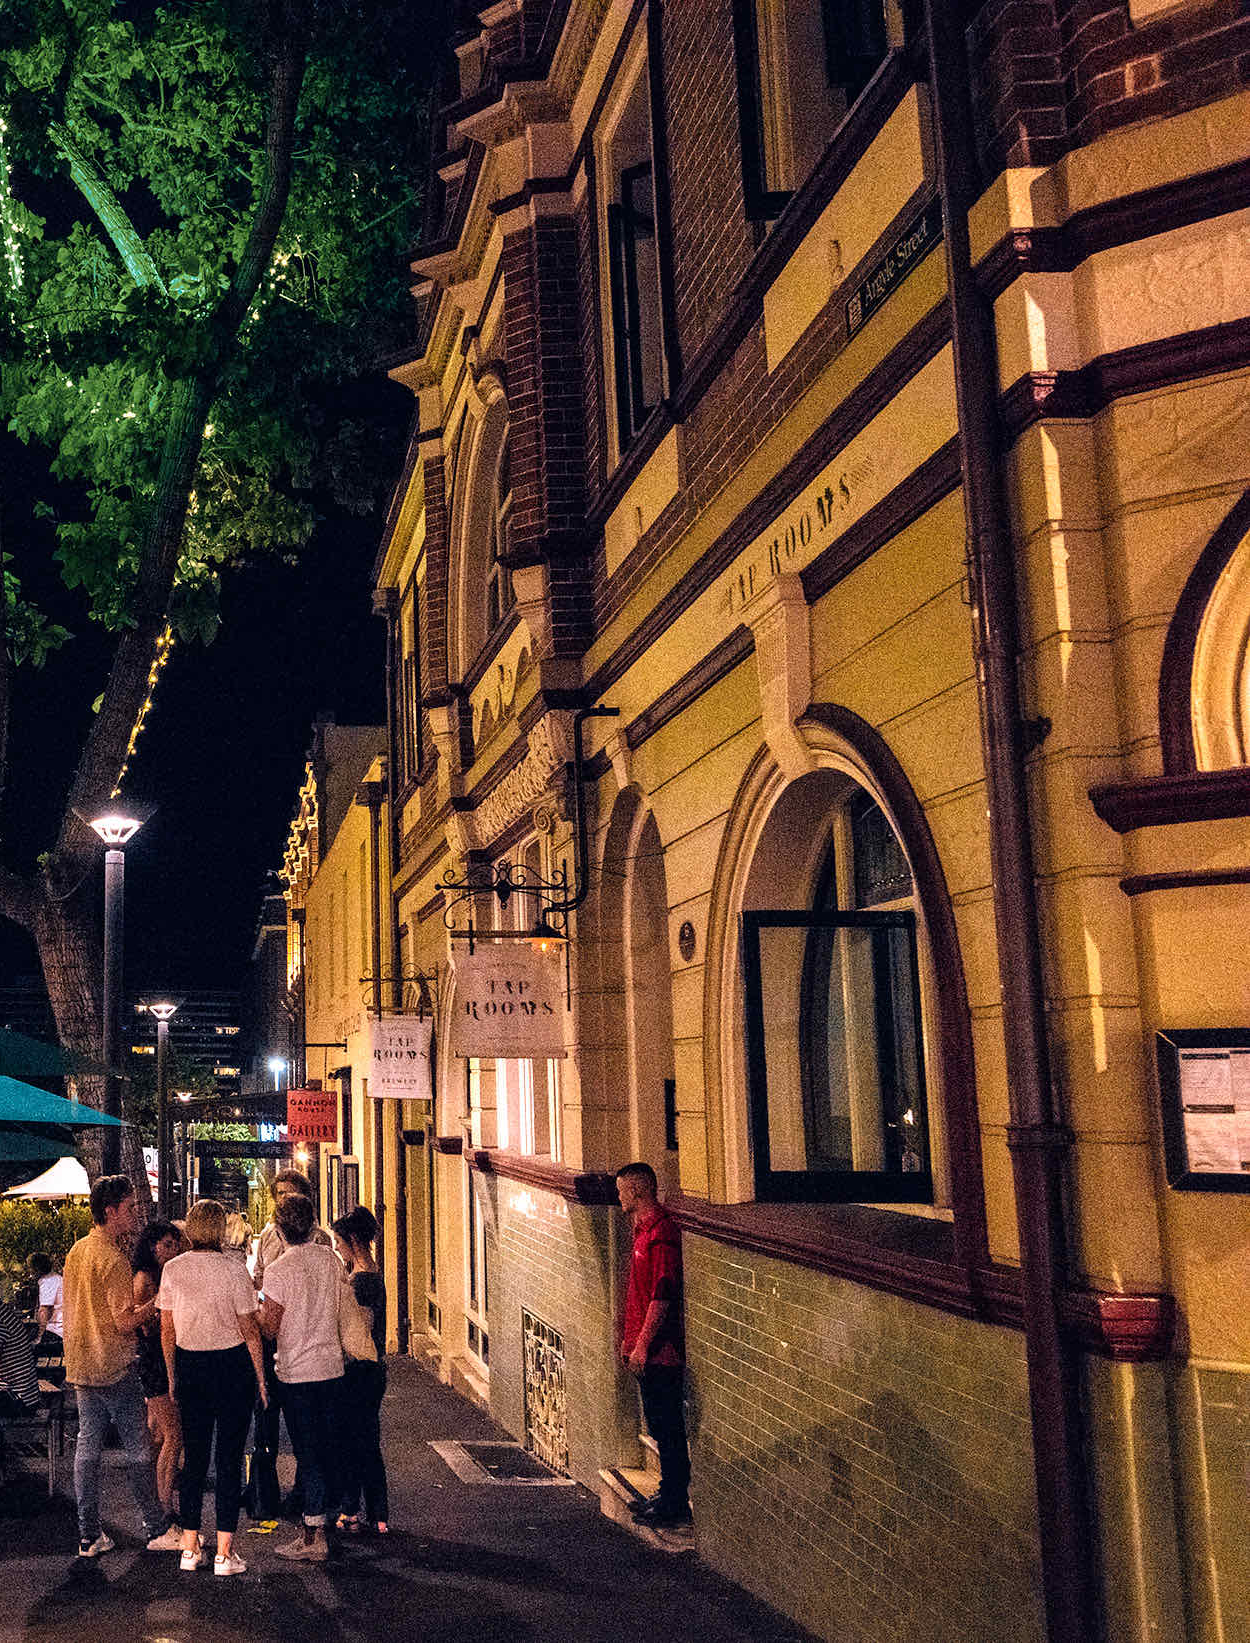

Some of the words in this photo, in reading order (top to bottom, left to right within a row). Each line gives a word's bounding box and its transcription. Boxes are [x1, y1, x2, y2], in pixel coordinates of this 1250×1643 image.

[863, 257, 896, 308] Argyle
[896, 216, 927, 268] Street
[723, 563, 757, 617] TAP
[768, 472, 851, 577] ROOMS
[485, 980, 530, 995] TAP
[465, 1000, 554, 1021] ROOMS
[389, 1037, 415, 1047] TAP
[373, 1049, 428, 1062] ROOMS
[290, 1124, 336, 1138] GALLERY
